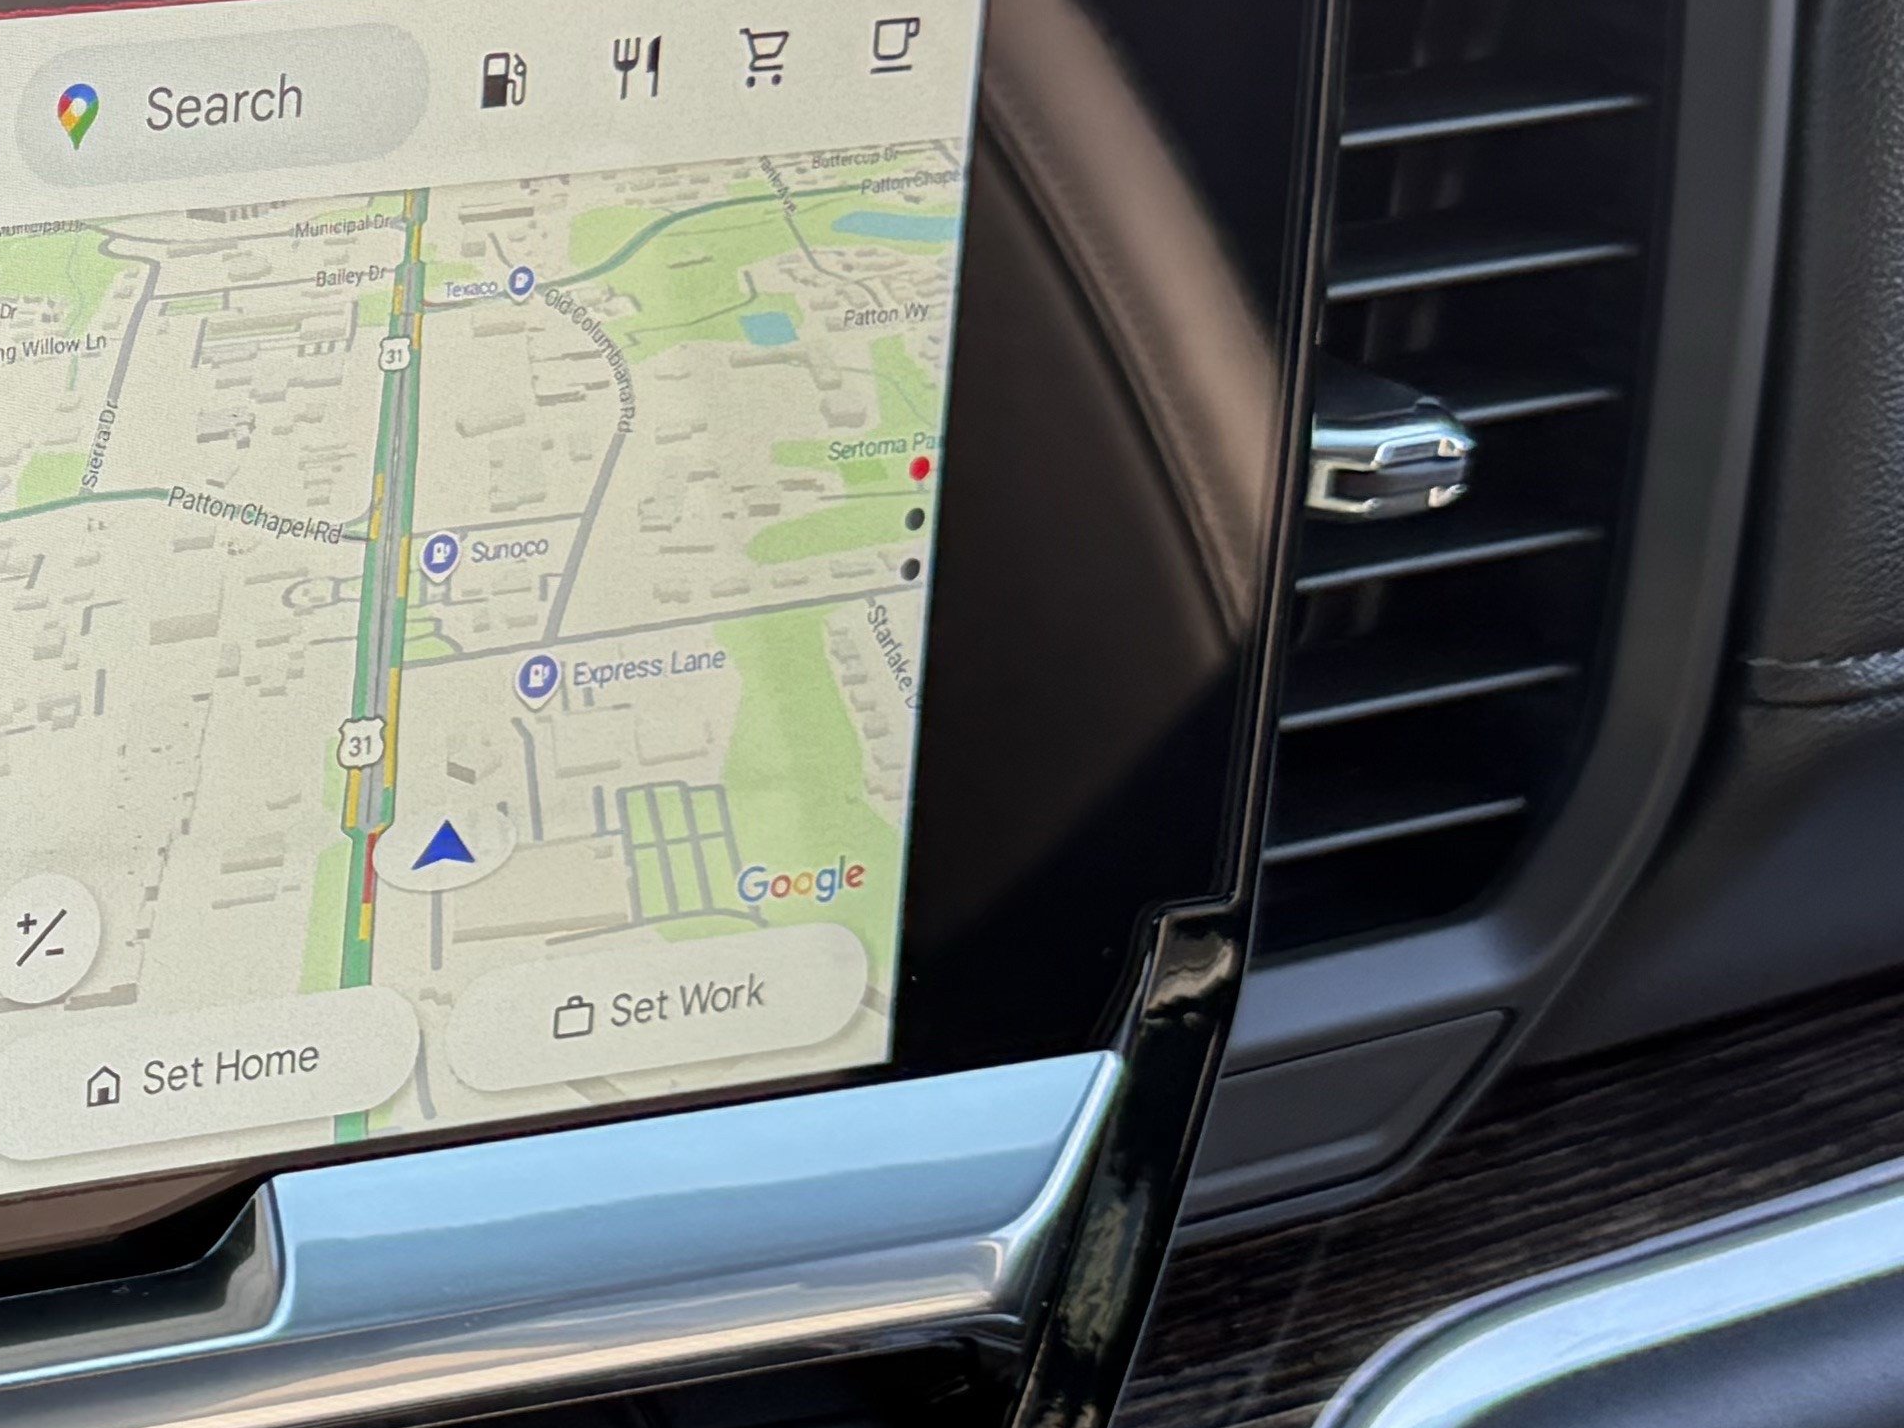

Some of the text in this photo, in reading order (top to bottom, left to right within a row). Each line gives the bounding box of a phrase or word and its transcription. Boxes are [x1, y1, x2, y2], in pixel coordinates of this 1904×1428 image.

[146, 72, 303, 131] Search
[860, 175, 911, 195] Patton
[294, 213, 391, 239] Municipal Dr
[315, 264, 387, 288] Bailey Dr
[444, 280, 498, 299] Texaco
[0, 303, 18, 320] Dr
[843, 302, 930, 328] Patton Wy
[22, 337, 81, 358] Willow
[85, 332, 107, 351] Ln
[384, 348, 403, 365] 31
[544, 288, 574, 316] Old
[571, 305, 635, 404] Columbiana
[81, 400, 118, 488] Sierra Dr
[827, 436, 907, 462] Sertoma
[167, 485, 343, 545] Patton Chapel Rd
[470, 538, 549, 564] Sunoco
[867, 604, 913, 692] Starlake
[573, 649, 727, 690] Express Lane
[348, 734, 373, 758] 31
[737, 854, 867, 903] Google
[609, 972, 766, 1028] Set Work
[142, 1045, 320, 1096] Set Home
